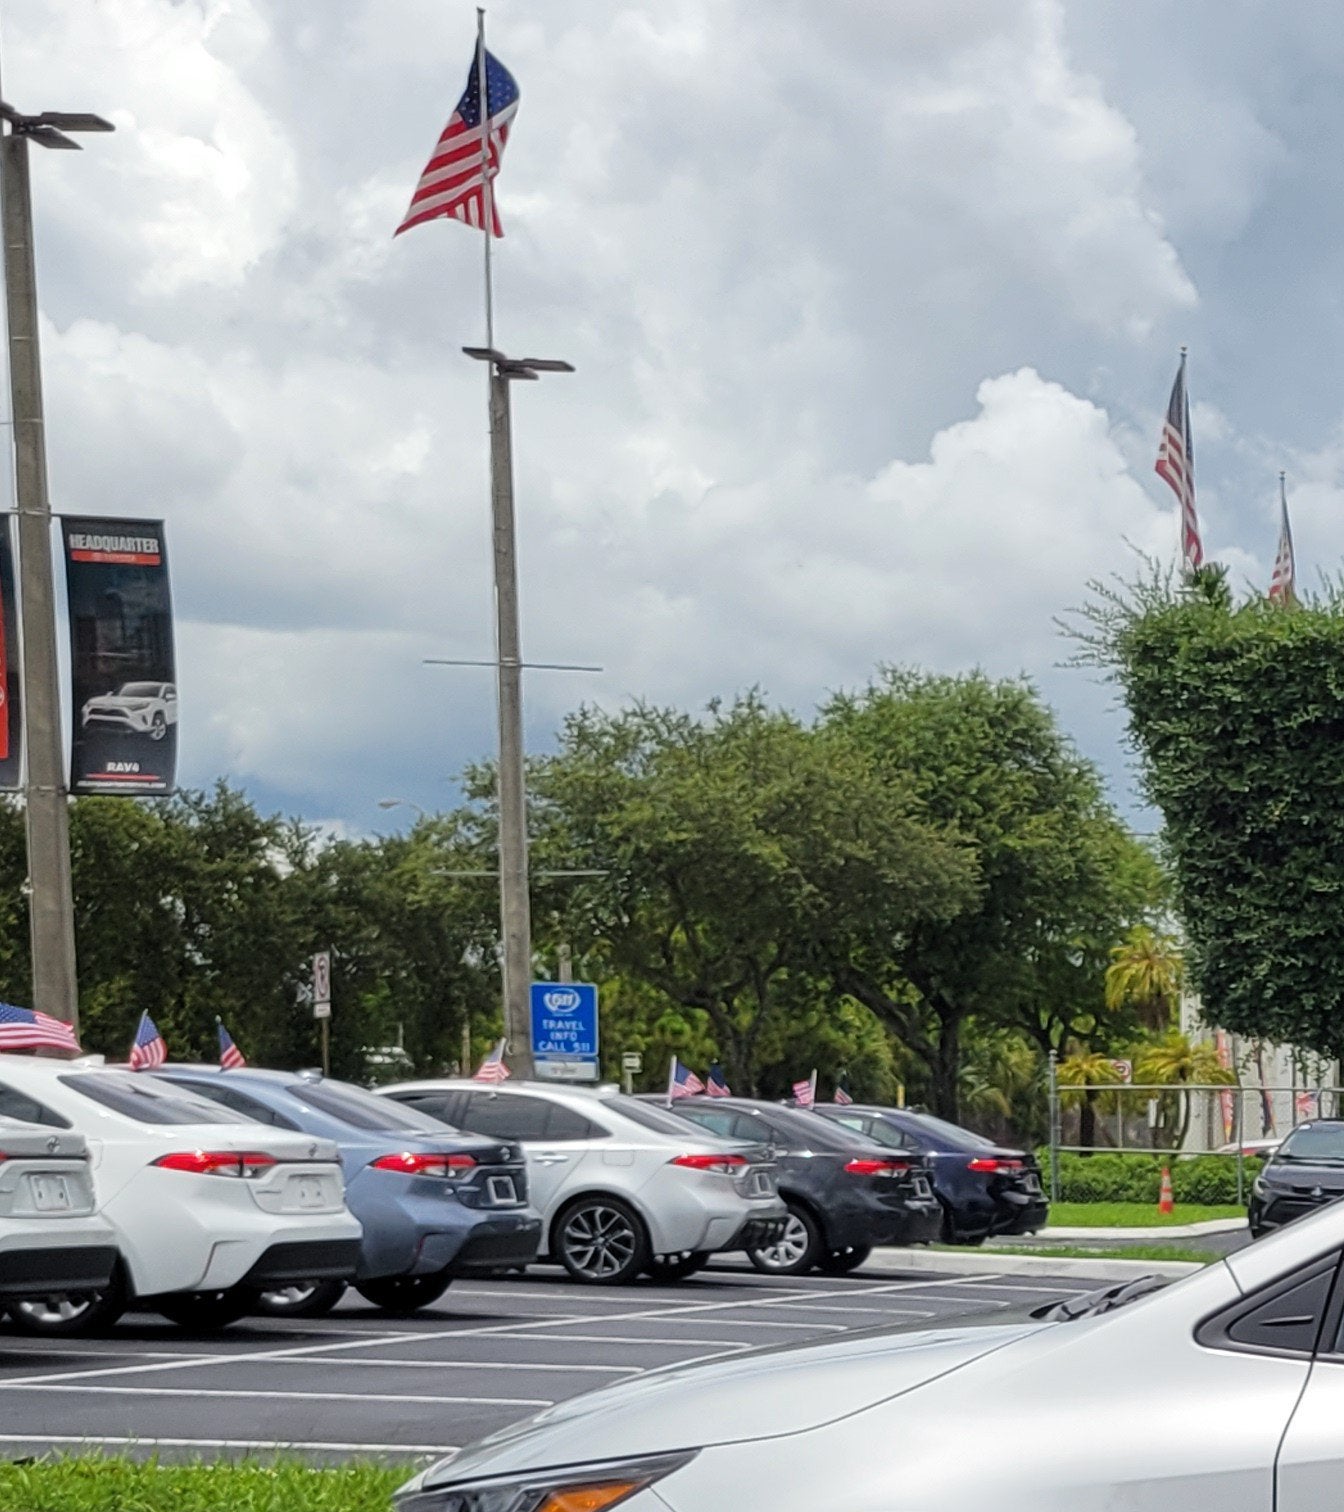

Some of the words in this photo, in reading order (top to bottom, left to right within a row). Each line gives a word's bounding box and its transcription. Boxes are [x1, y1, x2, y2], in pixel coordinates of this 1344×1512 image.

[69, 534, 159, 553] HEADQUARTER
[106, 761, 140, 772] RAV4
[542, 1019, 585, 1030] TRAVEL
[549, 1031, 578, 1041] INFO
[538, 1040, 566, 1052] CALL
